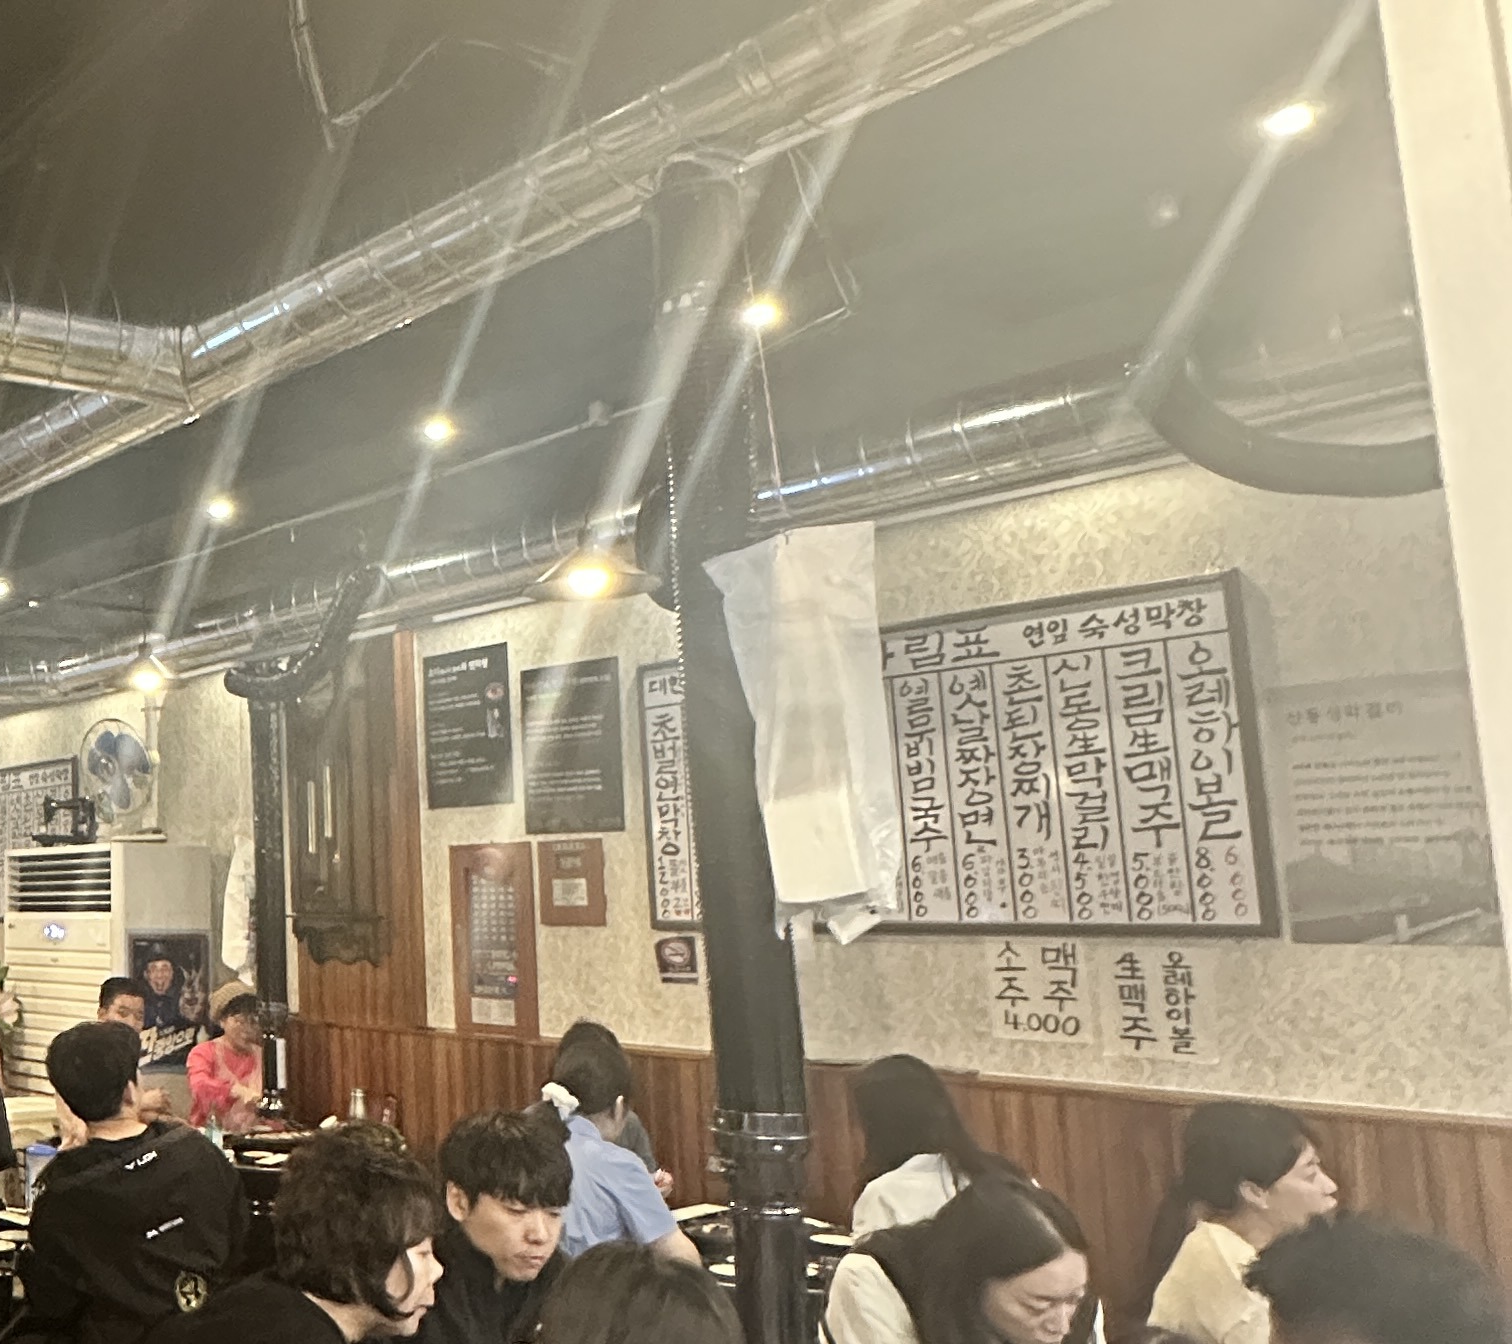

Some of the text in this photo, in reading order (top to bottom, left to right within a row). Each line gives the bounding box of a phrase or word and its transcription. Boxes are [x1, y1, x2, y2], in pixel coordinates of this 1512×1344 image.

[1078, 597, 1208, 640] 숙성막창
[995, 940, 1030, 1008] 소주
[1041, 942, 1079, 1013] 맥주
